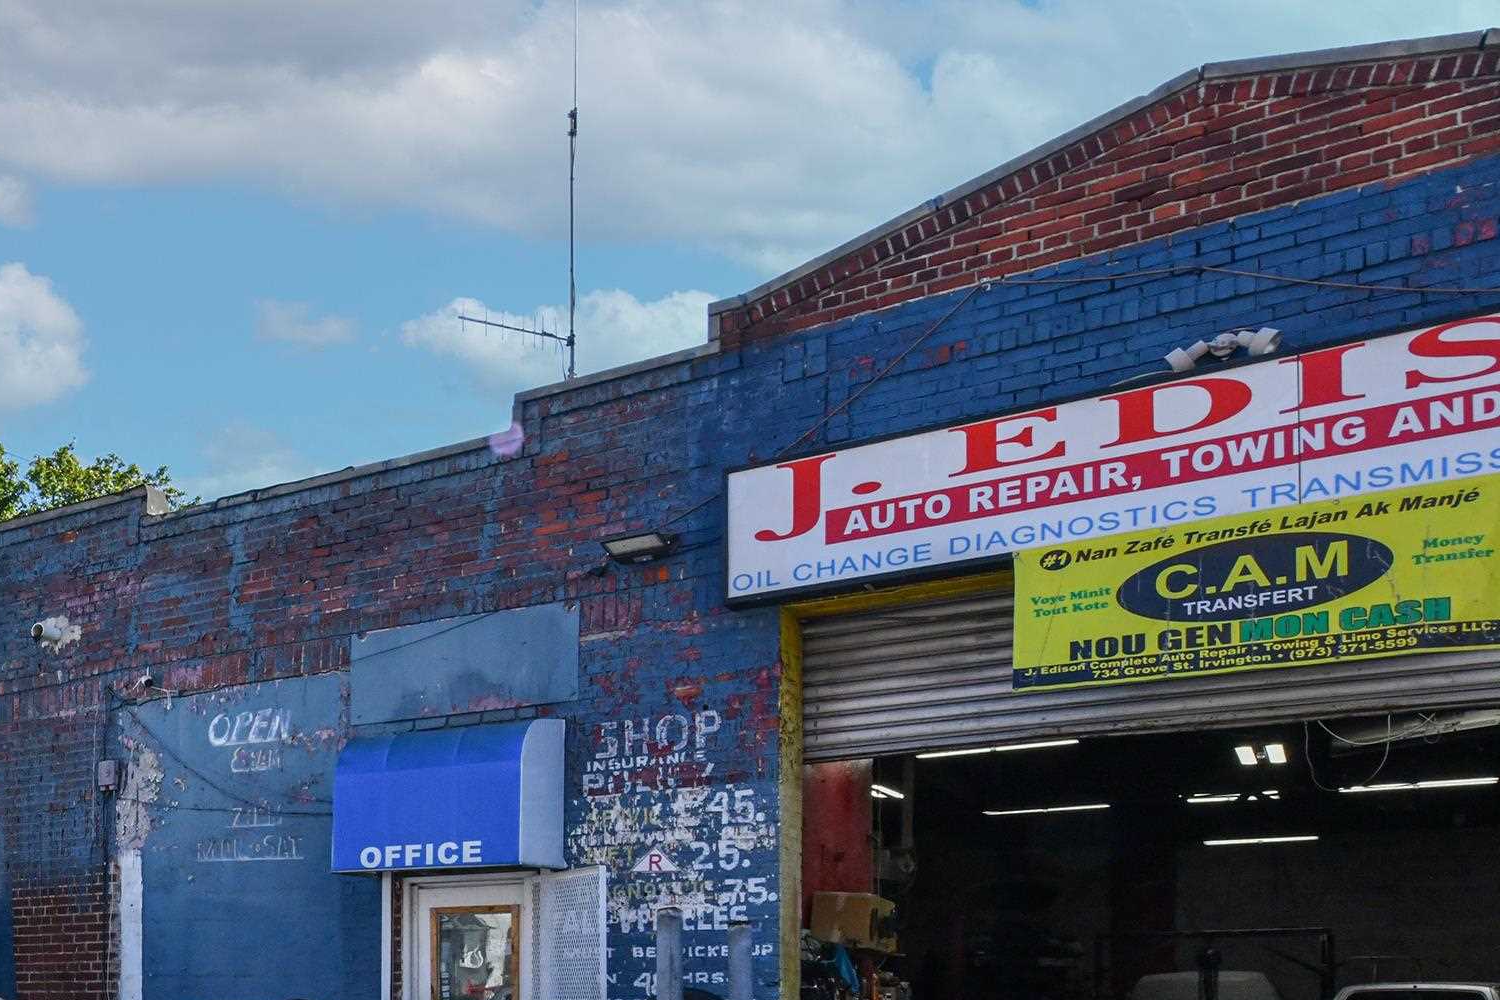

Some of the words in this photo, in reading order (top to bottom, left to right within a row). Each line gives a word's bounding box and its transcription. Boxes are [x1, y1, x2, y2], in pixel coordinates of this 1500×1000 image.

[843, 493, 951, 535] AUTO
[968, 461, 1142, 513] REPAIR,
[1160, 416, 1366, 478] TOWING
[1387, 390, 1500, 438] AND
[1075, 547, 1117, 563] Nan
[1124, 535, 1175, 556] Zafé
[1184, 523, 1272, 545] Transfé
[1280, 510, 1348, 531] Lajan
[1355, 502, 1391, 519] Ak
[1399, 487, 1481, 511] Manjé
[1423, 533, 1485, 550] Money
[732, 570, 781, 593] OIL
[793, 543, 932, 581] CHANGE
[950, 496, 1217, 555] DIAGNOSTICS
[1412, 546, 1494, 566] Transfer
[1032, 605, 1068, 618] Tout
[1072, 600, 1109, 613] Kote
[1070, 586, 1112, 601] Minit
[1183, 586, 1319, 616] TRANSFERT
[1069, 633, 1146, 662] NOU
[1157, 623, 1232, 651] GEN
[1239, 610, 1330, 643] MON
[1339, 596, 1452, 632] CASH
[1024, 667, 1037, 677] J.
[1041, 662, 1086, 675] Edison
[1090, 655, 1157, 670] Complete
[1161, 651, 1195, 662] Auto
[1199, 646, 1246, 660] Repair
[1266, 639, 1319, 651] Towing
[1325, 635, 1336, 645] &
[1341, 631, 1381, 643] Limo
[1386, 624, 1457, 638] Services
[1092, 668, 1120, 679] 734
[1123, 664, 1168, 676] Grove
[1173, 659, 1194, 671] St.
[1199, 651, 1272, 669] Irvington
[1290, 647, 1333, 661] (973)
[1338, 637, 1418, 654] 371-5599
[208, 708, 292, 747] OPEN
[595, 709, 722, 759] SHOP
[360, 840, 482, 869] OFFICE
[649, 854, 662, 872] R
[632, 946, 657, 958] BE
[682, 945, 729, 958] ICKE
